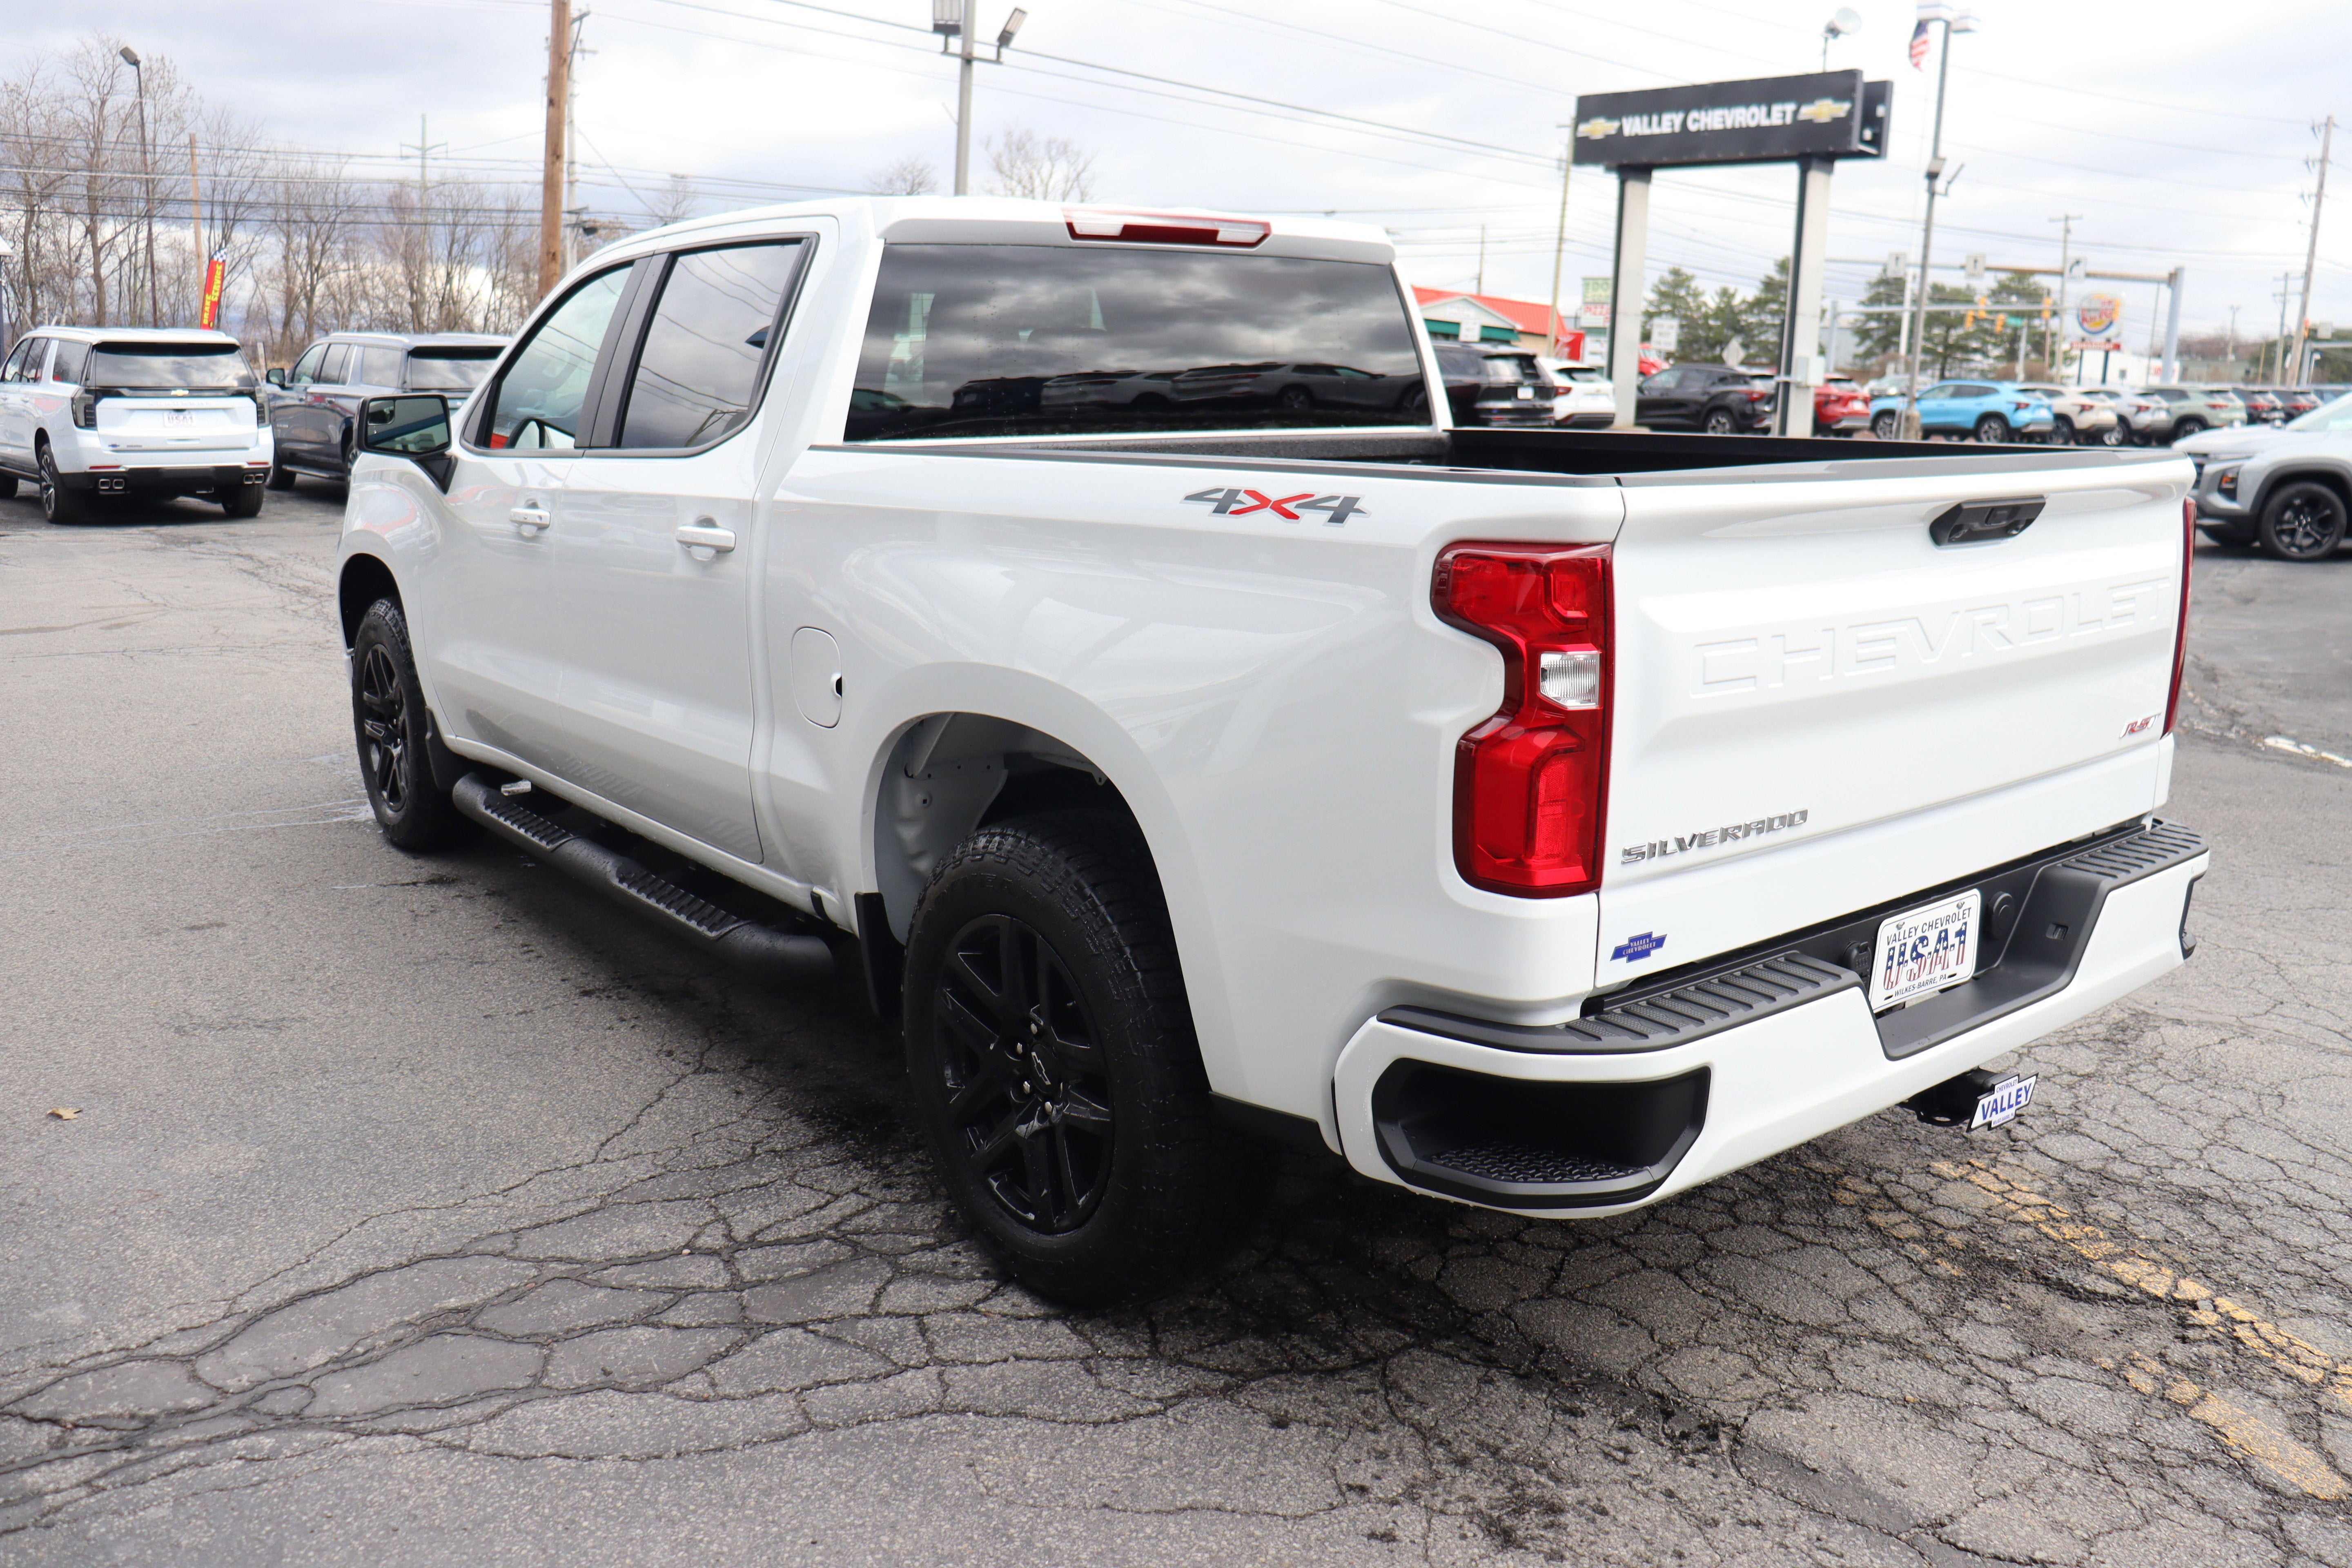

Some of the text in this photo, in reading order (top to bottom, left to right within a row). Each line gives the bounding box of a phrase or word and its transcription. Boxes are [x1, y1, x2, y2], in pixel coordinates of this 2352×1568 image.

[1621, 102, 1796, 137] VALLEY CHEVROLET
[211, 263, 223, 302] SERVICE
[1690, 576, 2170, 699] CHEVROLET
[2119, 712, 2161, 738] RST
[1621, 808, 1808, 864] SILVERADO
[1630, 938, 1650, 947] VALLEY
[1887, 907, 1971, 946] VALLEY CHEVROLET
[1622, 942, 1656, 955] CHEVROLET
[1895, 973, 1947, 997] WILKES-BARRE, PA
[1982, 1082, 2032, 1120] VALLEY
[1996, 1079, 2018, 1093] CHEVROLET
